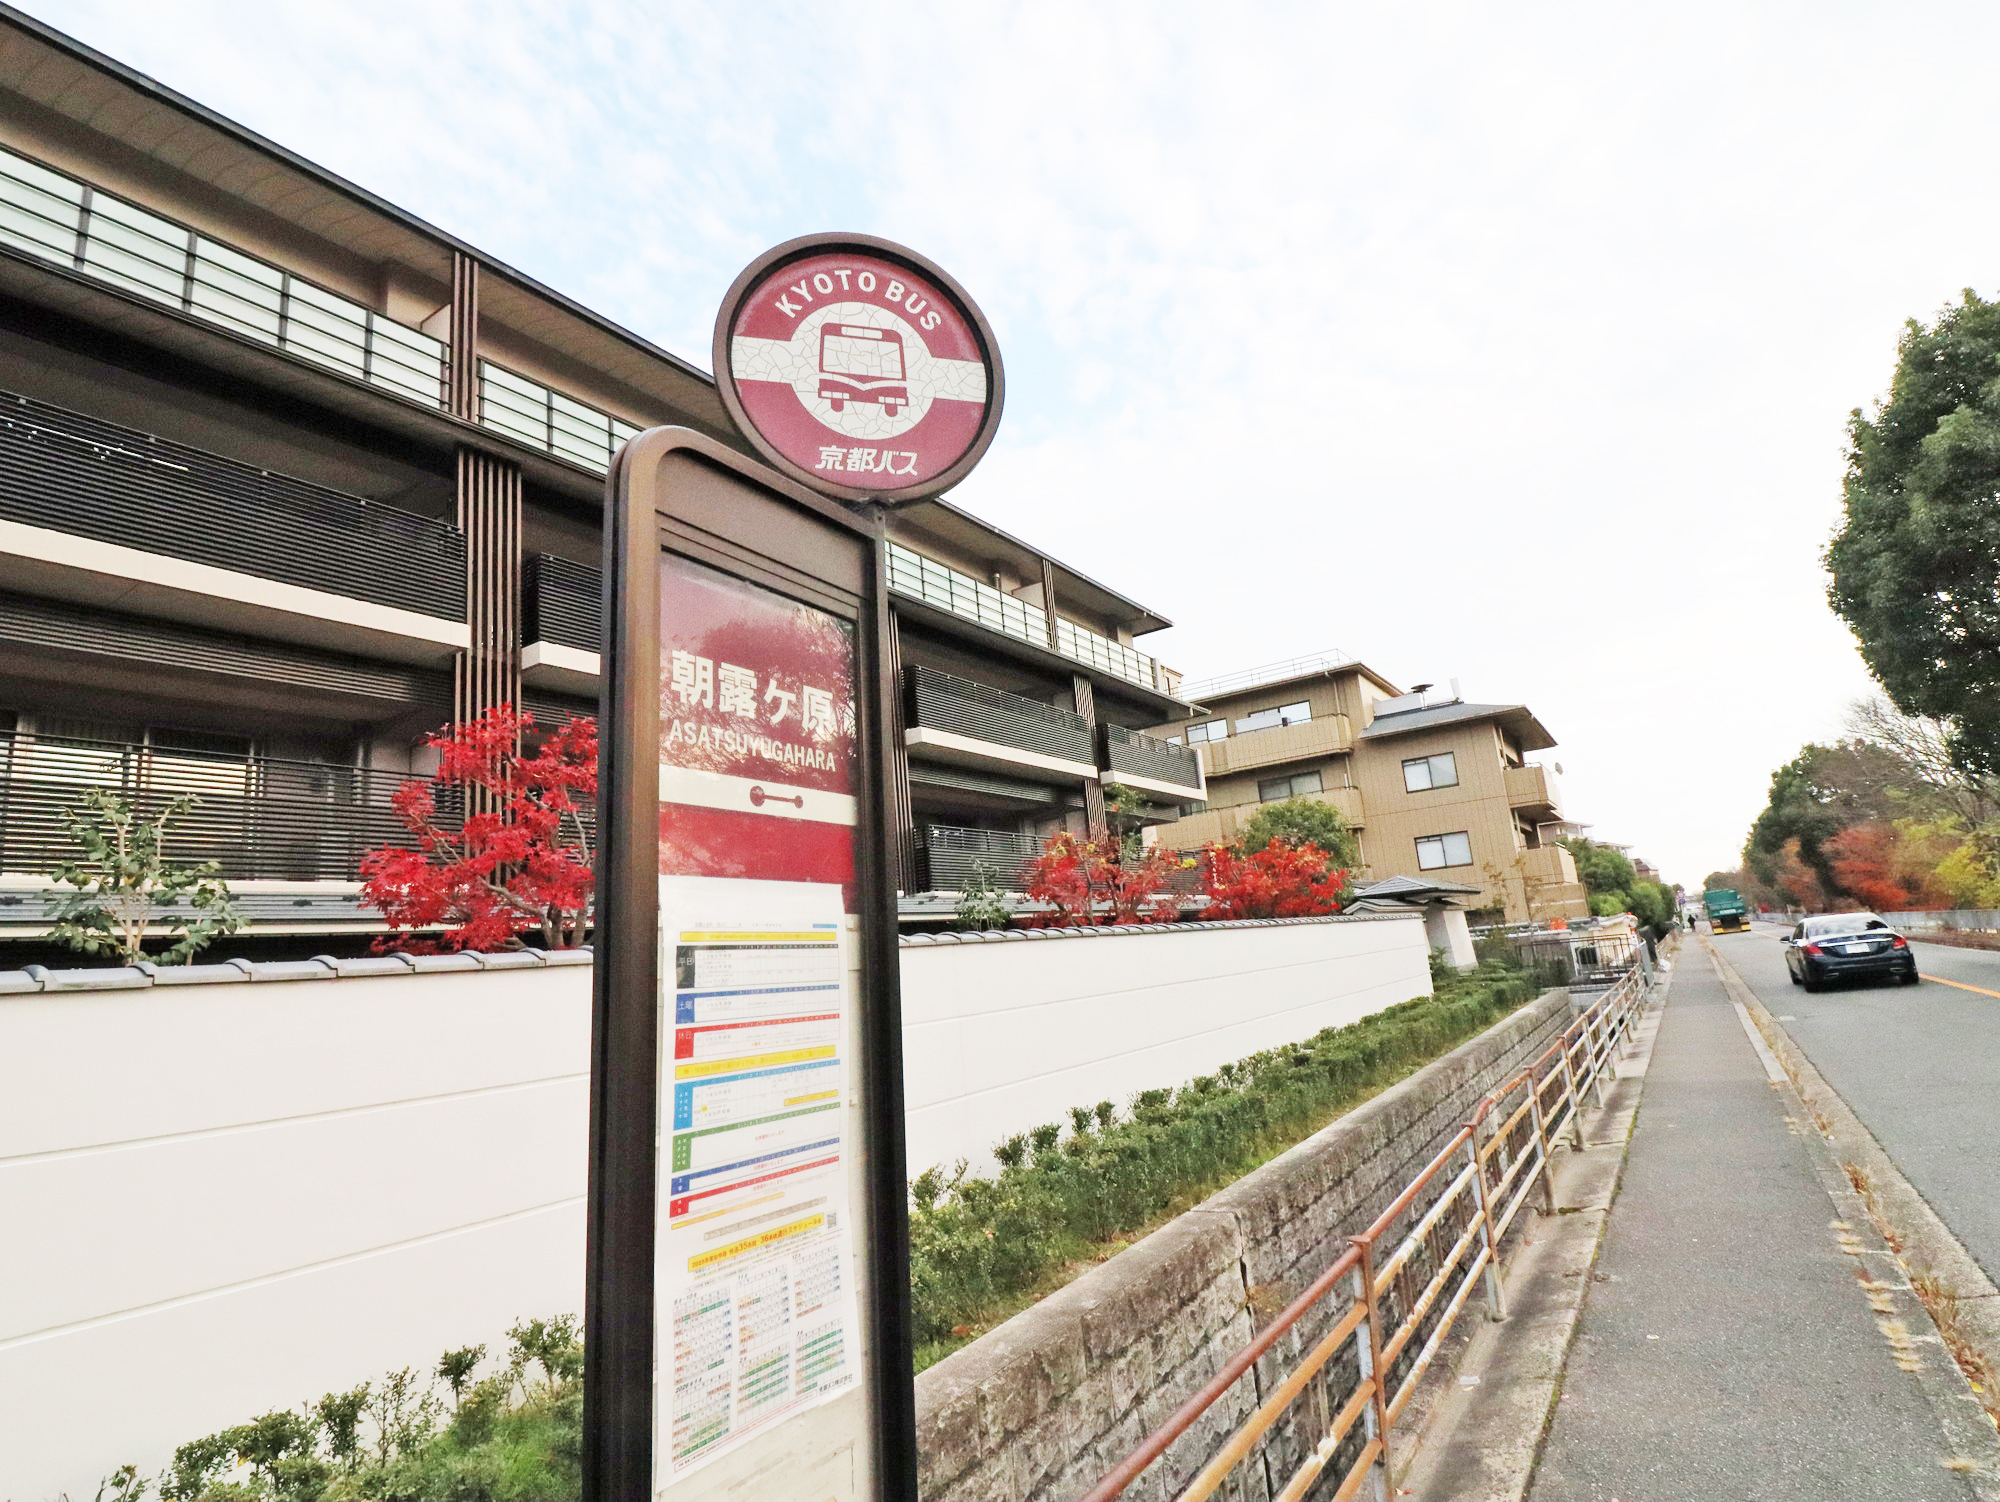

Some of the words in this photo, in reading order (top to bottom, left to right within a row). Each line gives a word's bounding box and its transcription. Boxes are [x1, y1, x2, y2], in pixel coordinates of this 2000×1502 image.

[775, 269, 876, 318] KYOTO
[885, 280, 942, 331] BUS
[815, 445, 918, 476] 京都バス
[670, 719, 836, 772] ASATSUYUGAHARA
